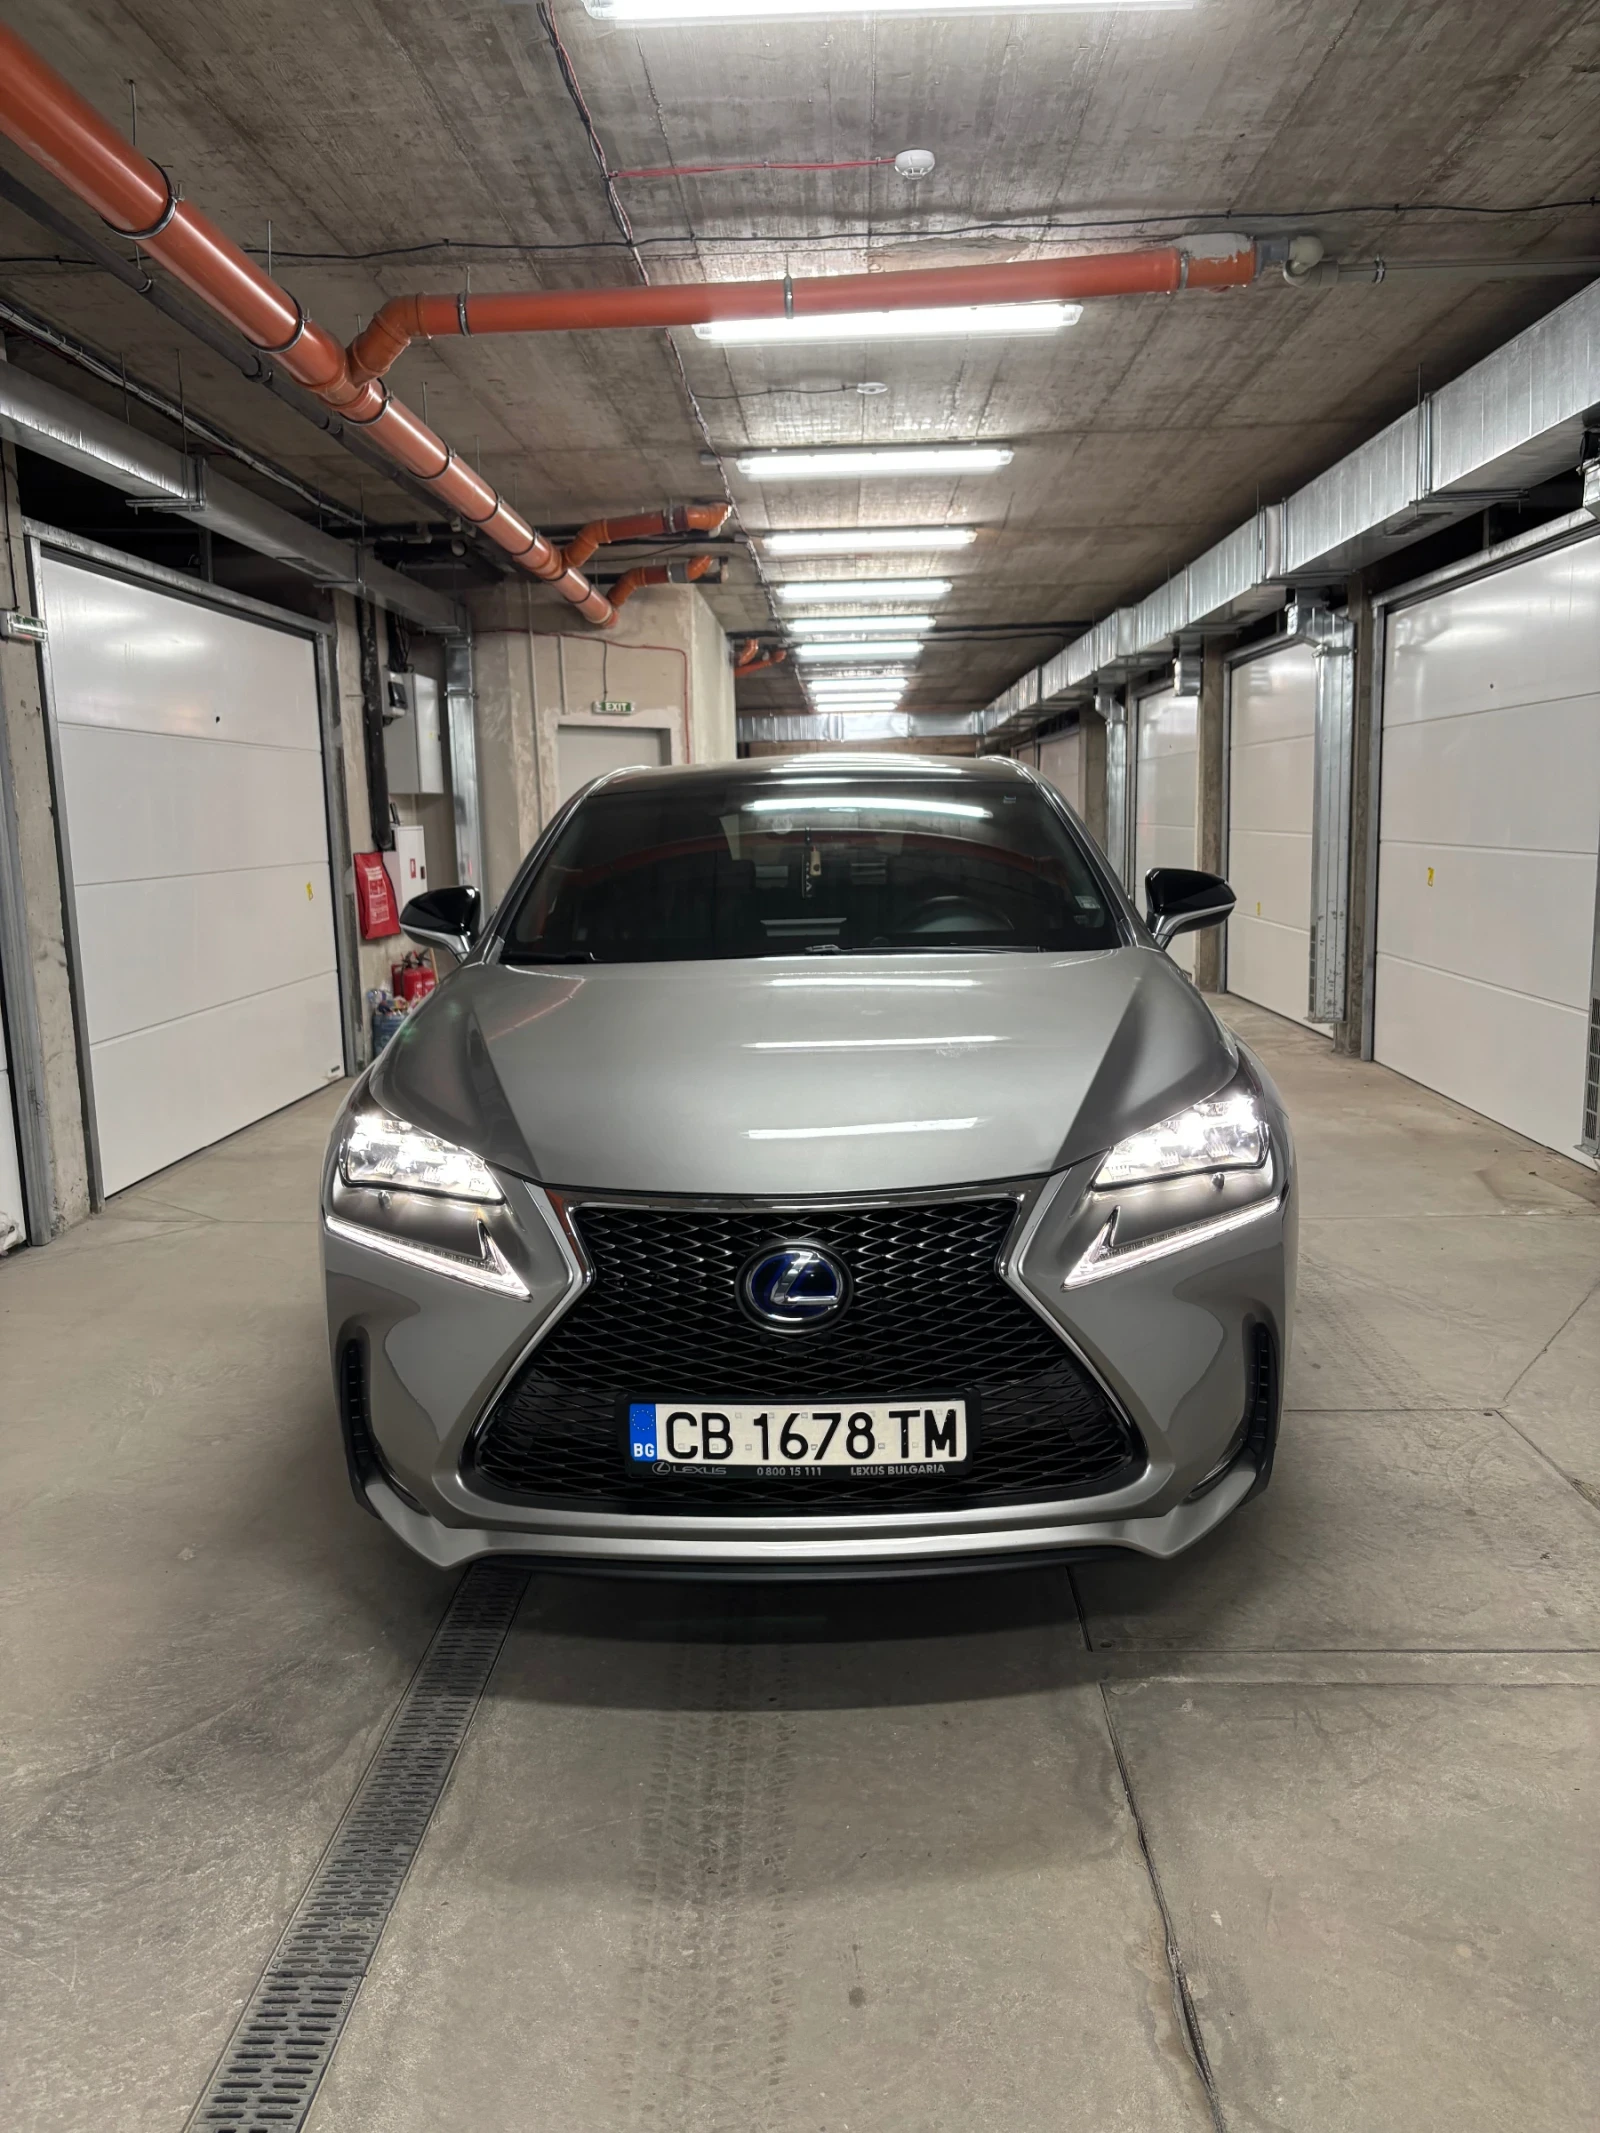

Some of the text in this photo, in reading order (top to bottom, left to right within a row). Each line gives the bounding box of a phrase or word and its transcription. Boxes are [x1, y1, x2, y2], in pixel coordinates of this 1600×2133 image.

[605, 702, 627, 711] EXIT
[666, 1408, 957, 1461] CB 1678 TM
[633, 1443, 655, 1458] BG
[672, 1465, 727, 1475] LEXUS
[789, 1467, 801, 1476] 15
[804, 1467, 822, 1476] 111
[850, 1464, 946, 1476] LEXUS BULGARIA
